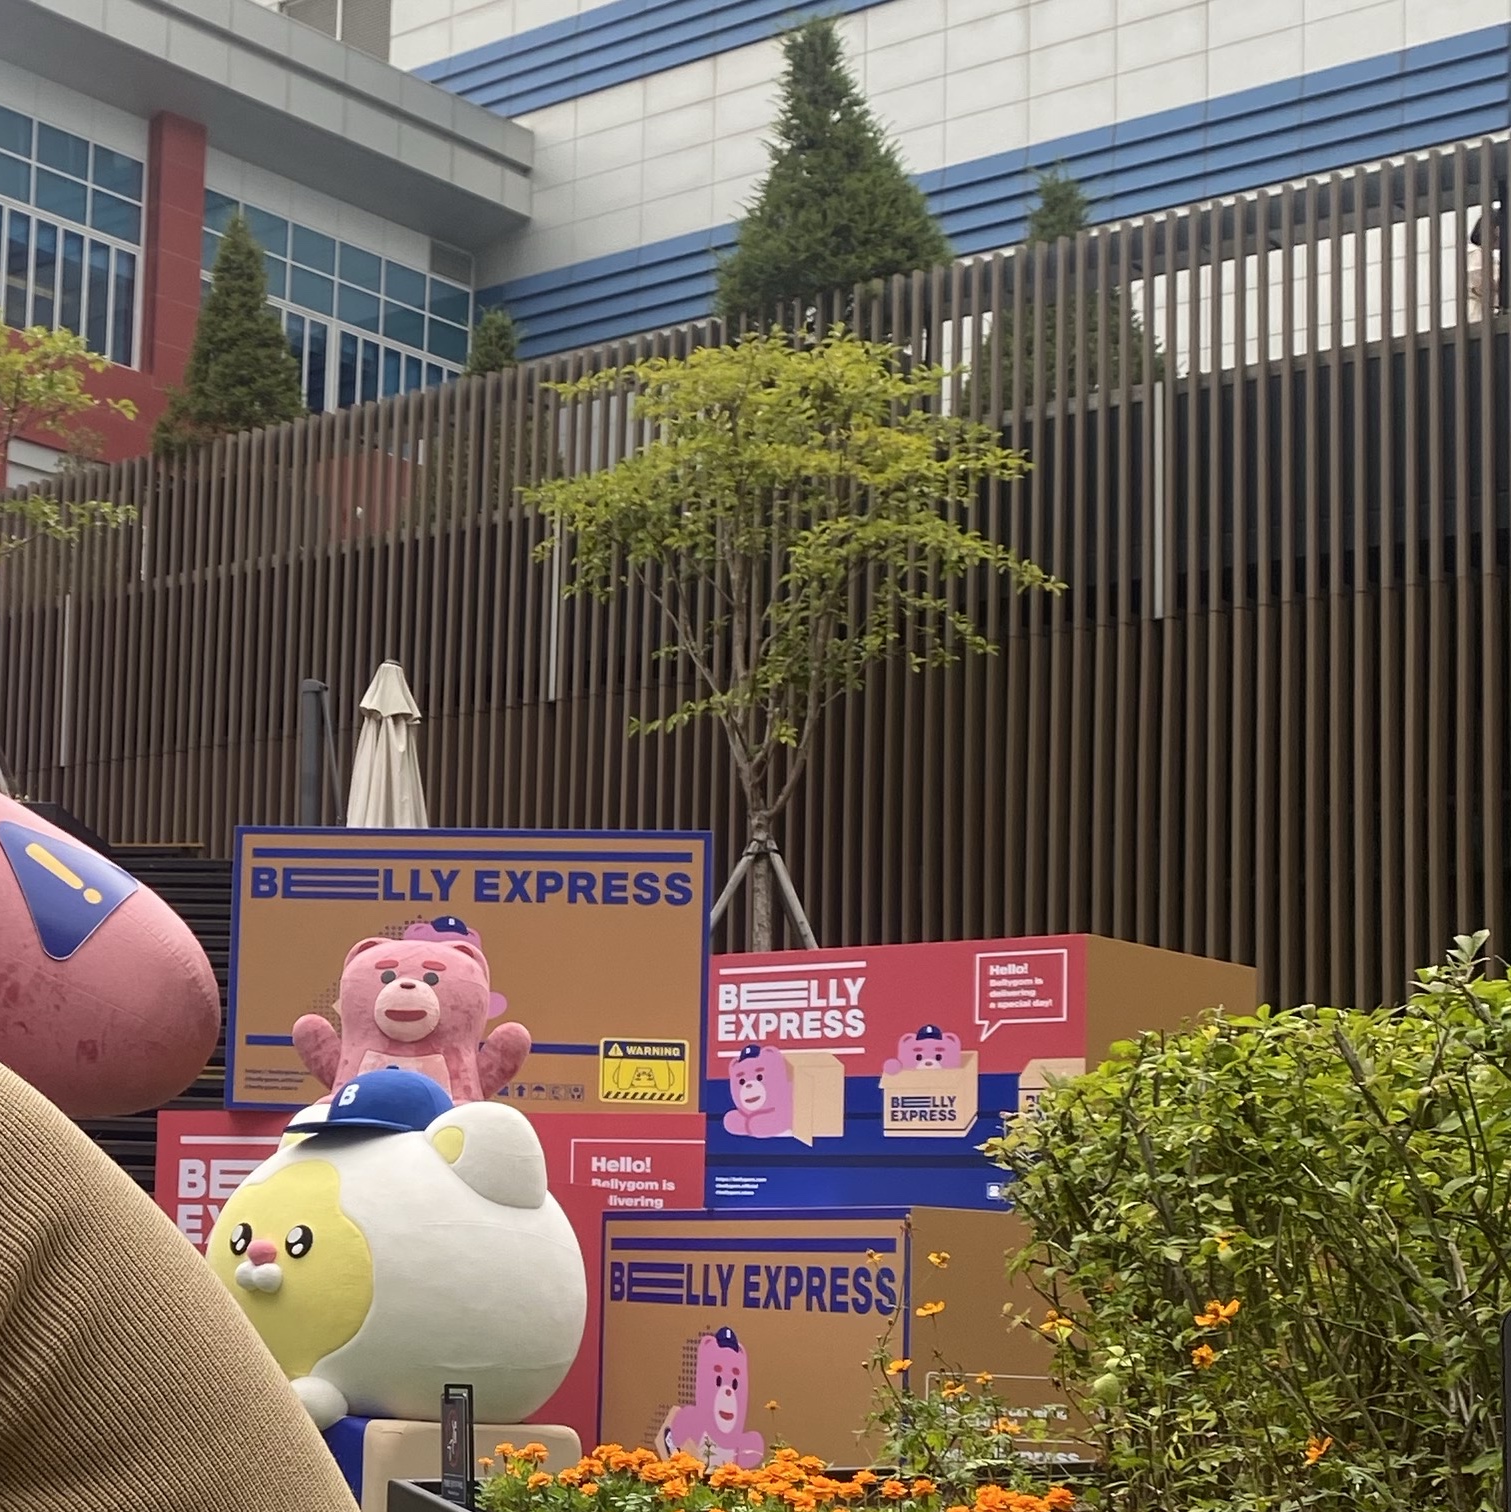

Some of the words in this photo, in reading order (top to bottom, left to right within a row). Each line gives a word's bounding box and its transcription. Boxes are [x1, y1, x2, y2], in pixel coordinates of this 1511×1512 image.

[250, 866, 461, 902] BELLY
[474, 869, 694, 906] EXPRESS
[718, 976, 867, 1012] BELLY
[717, 1008, 866, 1042] EXPRESS
[626, 1045, 681, 1057] WARNING
[338, 1083, 360, 1107] B
[890, 1095, 957, 1109] BELLY
[890, 1109, 957, 1122] EXPRESS
[591, 1156, 652, 1173] Hello!
[662, 1179, 676, 1191] is
[608, 1195, 664, 1209] livering
[610, 1261, 736, 1307] BELLY
[742, 1263, 897, 1316] EXPRESS
